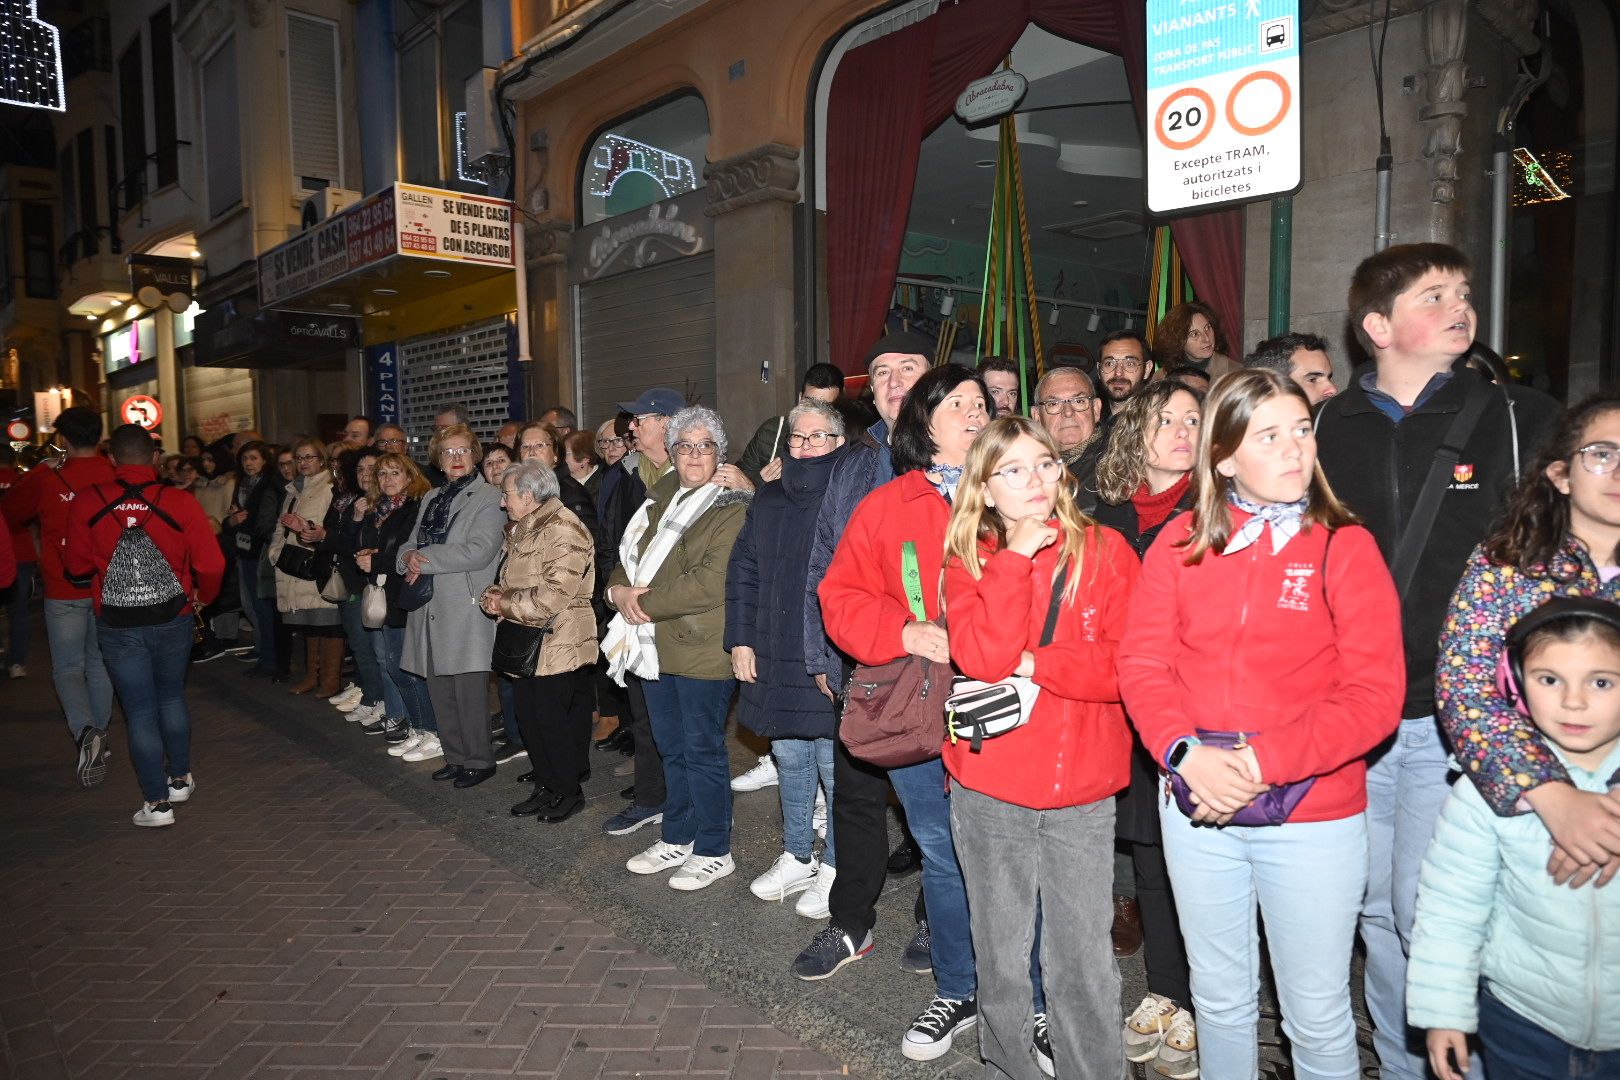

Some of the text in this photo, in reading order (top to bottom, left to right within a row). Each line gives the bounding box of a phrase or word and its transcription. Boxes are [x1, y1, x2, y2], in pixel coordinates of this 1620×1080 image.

[1152, 3, 1237, 37] VIANANTS
[1153, 37, 1221, 63] ZONA DE PAS
[1153, 53, 1214, 77] TRANSPORT
[1168, 107, 1202, 131] 20
[1174, 145, 1270, 171] Excepte TRAM,
[1183, 161, 1262, 186] autoritzats i
[401, 192, 433, 204] GALLEN
[1192, 183, 1251, 200] bicicletes
[362, 206, 371, 231] 22
[443, 199, 454, 214] SE
[456, 201, 484, 219] VENDE
[486, 206, 510, 223] CASA
[318, 219, 345, 261] CASA
[450, 219, 510, 241] DE 5 PLANTAS
[443, 237, 510, 258] CON ASCENSOR
[152, 271, 189, 285] VALLS
[379, 351, 395, 423] 4 PLANT
